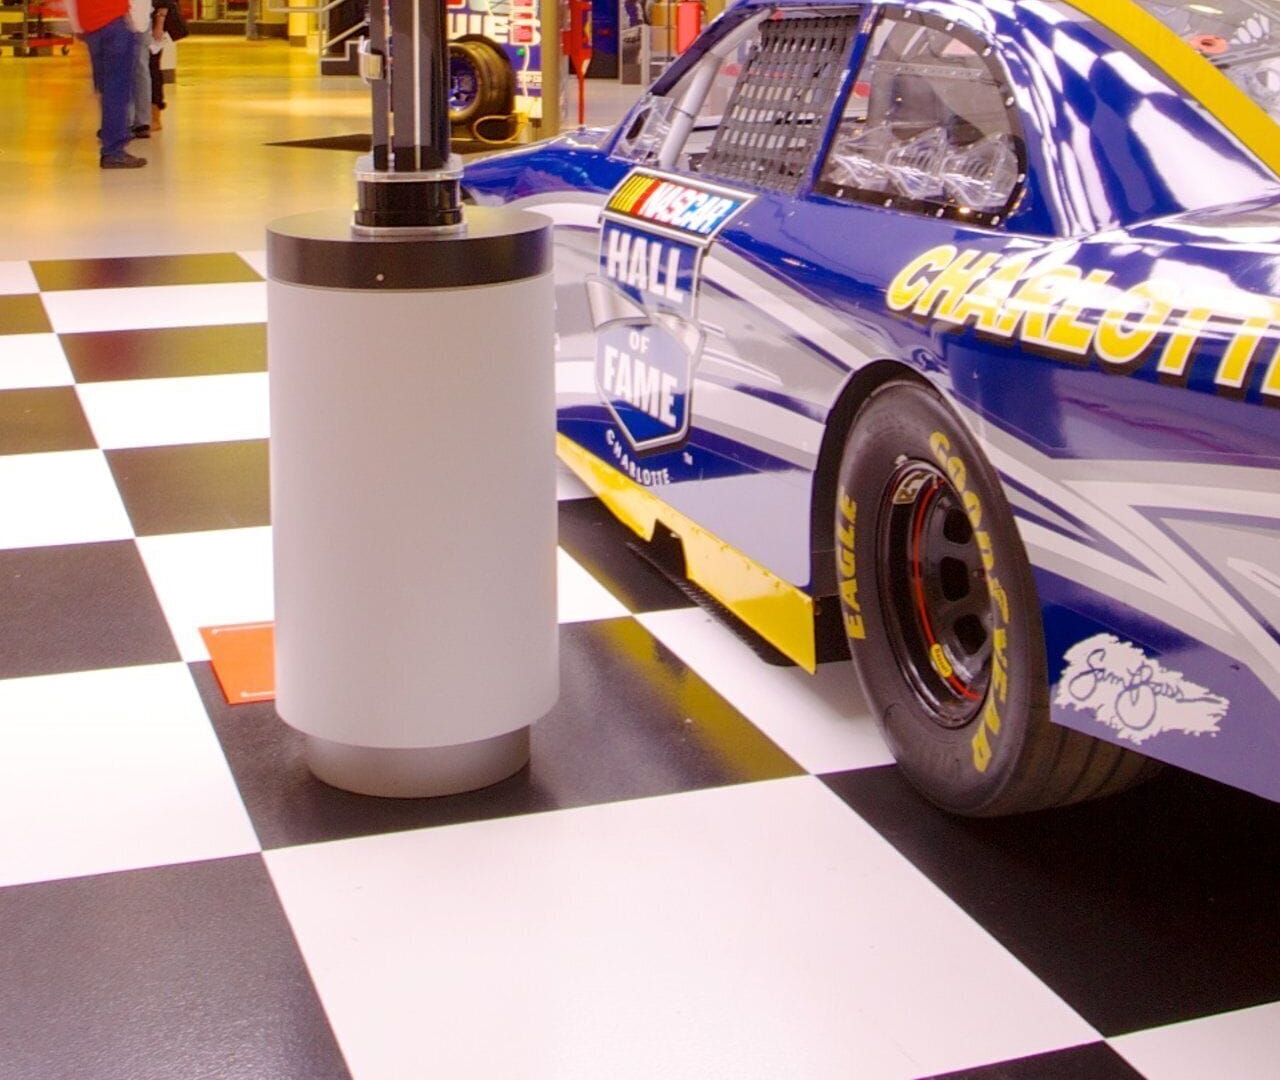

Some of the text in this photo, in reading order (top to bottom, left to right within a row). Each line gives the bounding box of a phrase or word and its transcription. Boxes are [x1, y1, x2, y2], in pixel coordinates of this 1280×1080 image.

[640, 181, 735, 234] NASCAR
[606, 229, 685, 303] HALL
[629, 330, 650, 354] OF
[603, 345, 678, 428] FAME
[605, 428, 671, 486] CHARLOTTE
[838, 486, 867, 640] EAGLE
